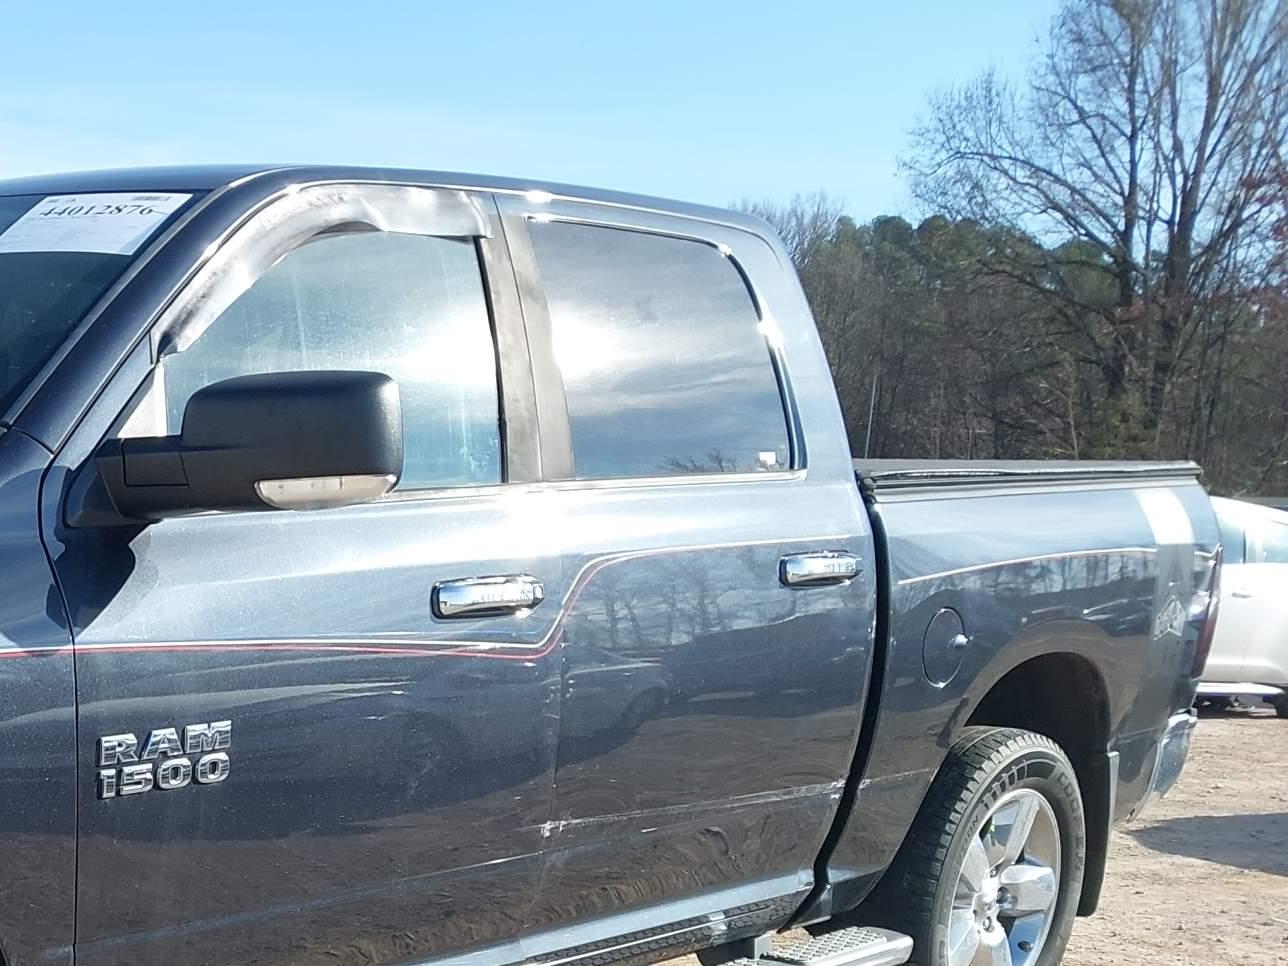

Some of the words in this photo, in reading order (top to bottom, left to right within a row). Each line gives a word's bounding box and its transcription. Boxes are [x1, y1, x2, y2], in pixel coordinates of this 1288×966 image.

[39, 204, 154, 217] 44012876
[97, 720, 232, 766] RAM
[97, 752, 230, 799] 1500
